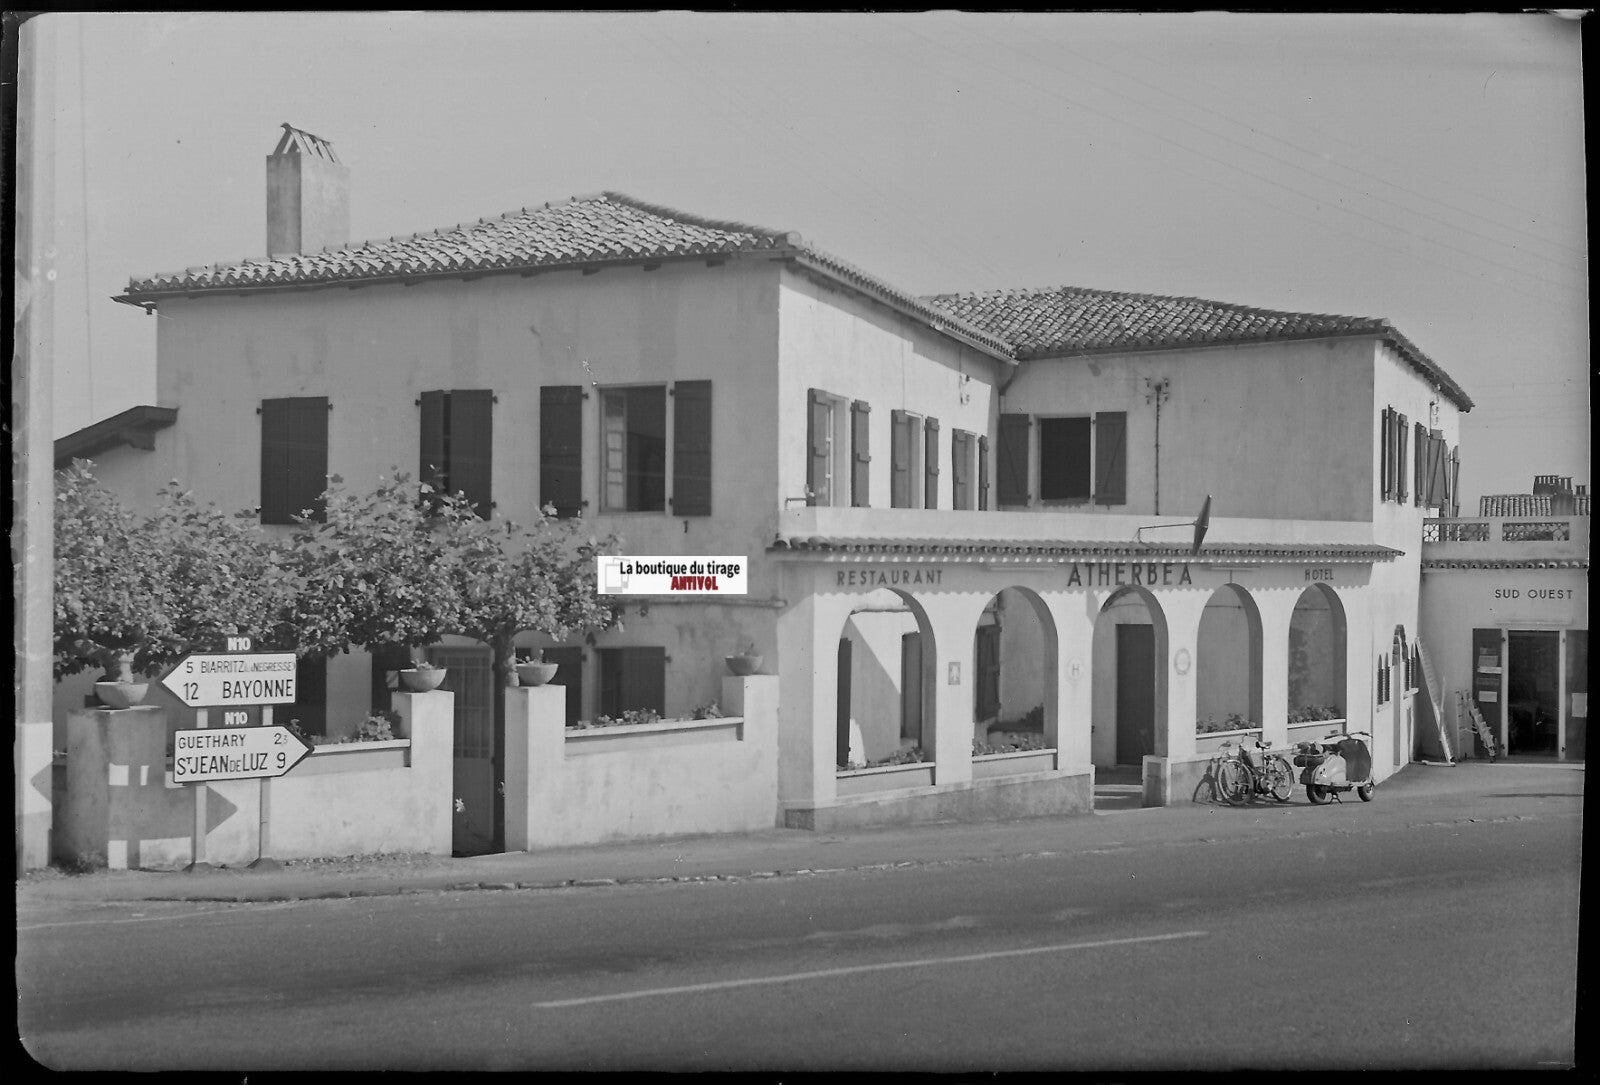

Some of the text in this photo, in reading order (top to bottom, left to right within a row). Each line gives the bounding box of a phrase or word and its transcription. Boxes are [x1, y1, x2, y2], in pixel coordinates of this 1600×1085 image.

[837, 570, 942, 586] RESTAURANT
[1067, 562, 1192, 587] ATHERBEA
[1305, 569, 1334, 580] HOTEL
[1495, 589, 1573, 599] SUD OUEST
[186, 661, 194, 673] 5
[201, 660, 244, 673] BIARRITZ
[183, 679, 293, 700] 12 BAYONNE
[224, 712, 248, 725] N10
[179, 734, 246, 749] GUETHARY
[277, 752, 286, 769] 9
